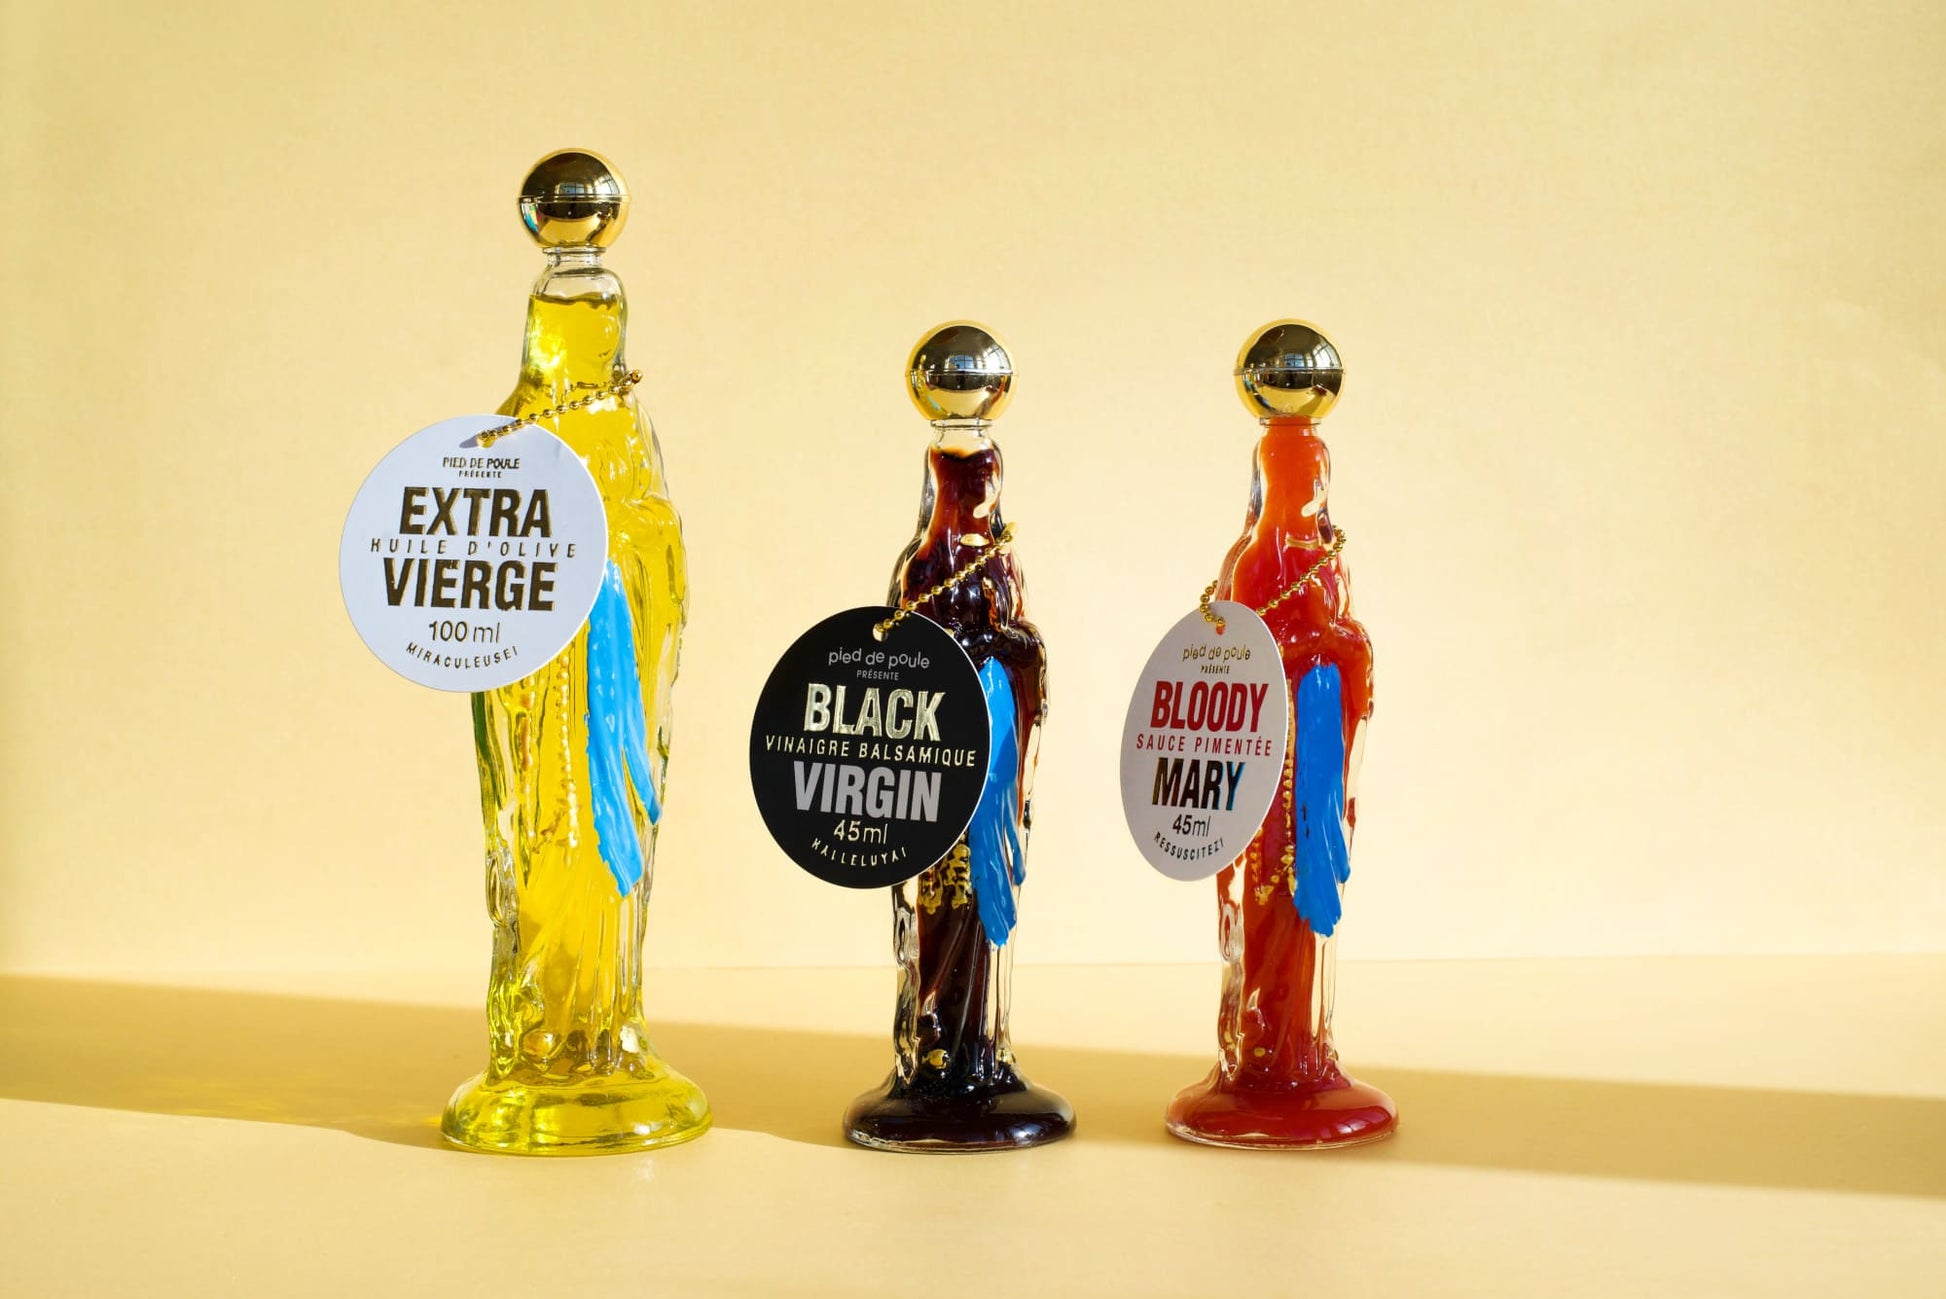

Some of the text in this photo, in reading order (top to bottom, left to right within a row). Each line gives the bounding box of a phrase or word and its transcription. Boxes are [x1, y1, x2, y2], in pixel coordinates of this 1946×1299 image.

[470, 458, 484, 468] DE
[487, 458, 520, 469] POULE
[399, 486, 552, 538] EXTRA
[371, 538, 576, 557] HUILE D'OLIVE
[384, 557, 558, 611] VIERGE
[829, 647, 929, 669] pied de poule
[1182, 643, 1251, 661] pied de poule
[857, 669, 899, 680] PRÉSENTE
[804, 683, 946, 742] BLACK
[1150, 680, 1269, 732] BLOODY
[766, 735, 976, 767] VINAIGRE BALSAMIQUE
[1136, 733, 1272, 756] SAUCE PIMENTÉE
[793, 761, 942, 822] VIRGIN
[1152, 757, 1245, 811] MARY
